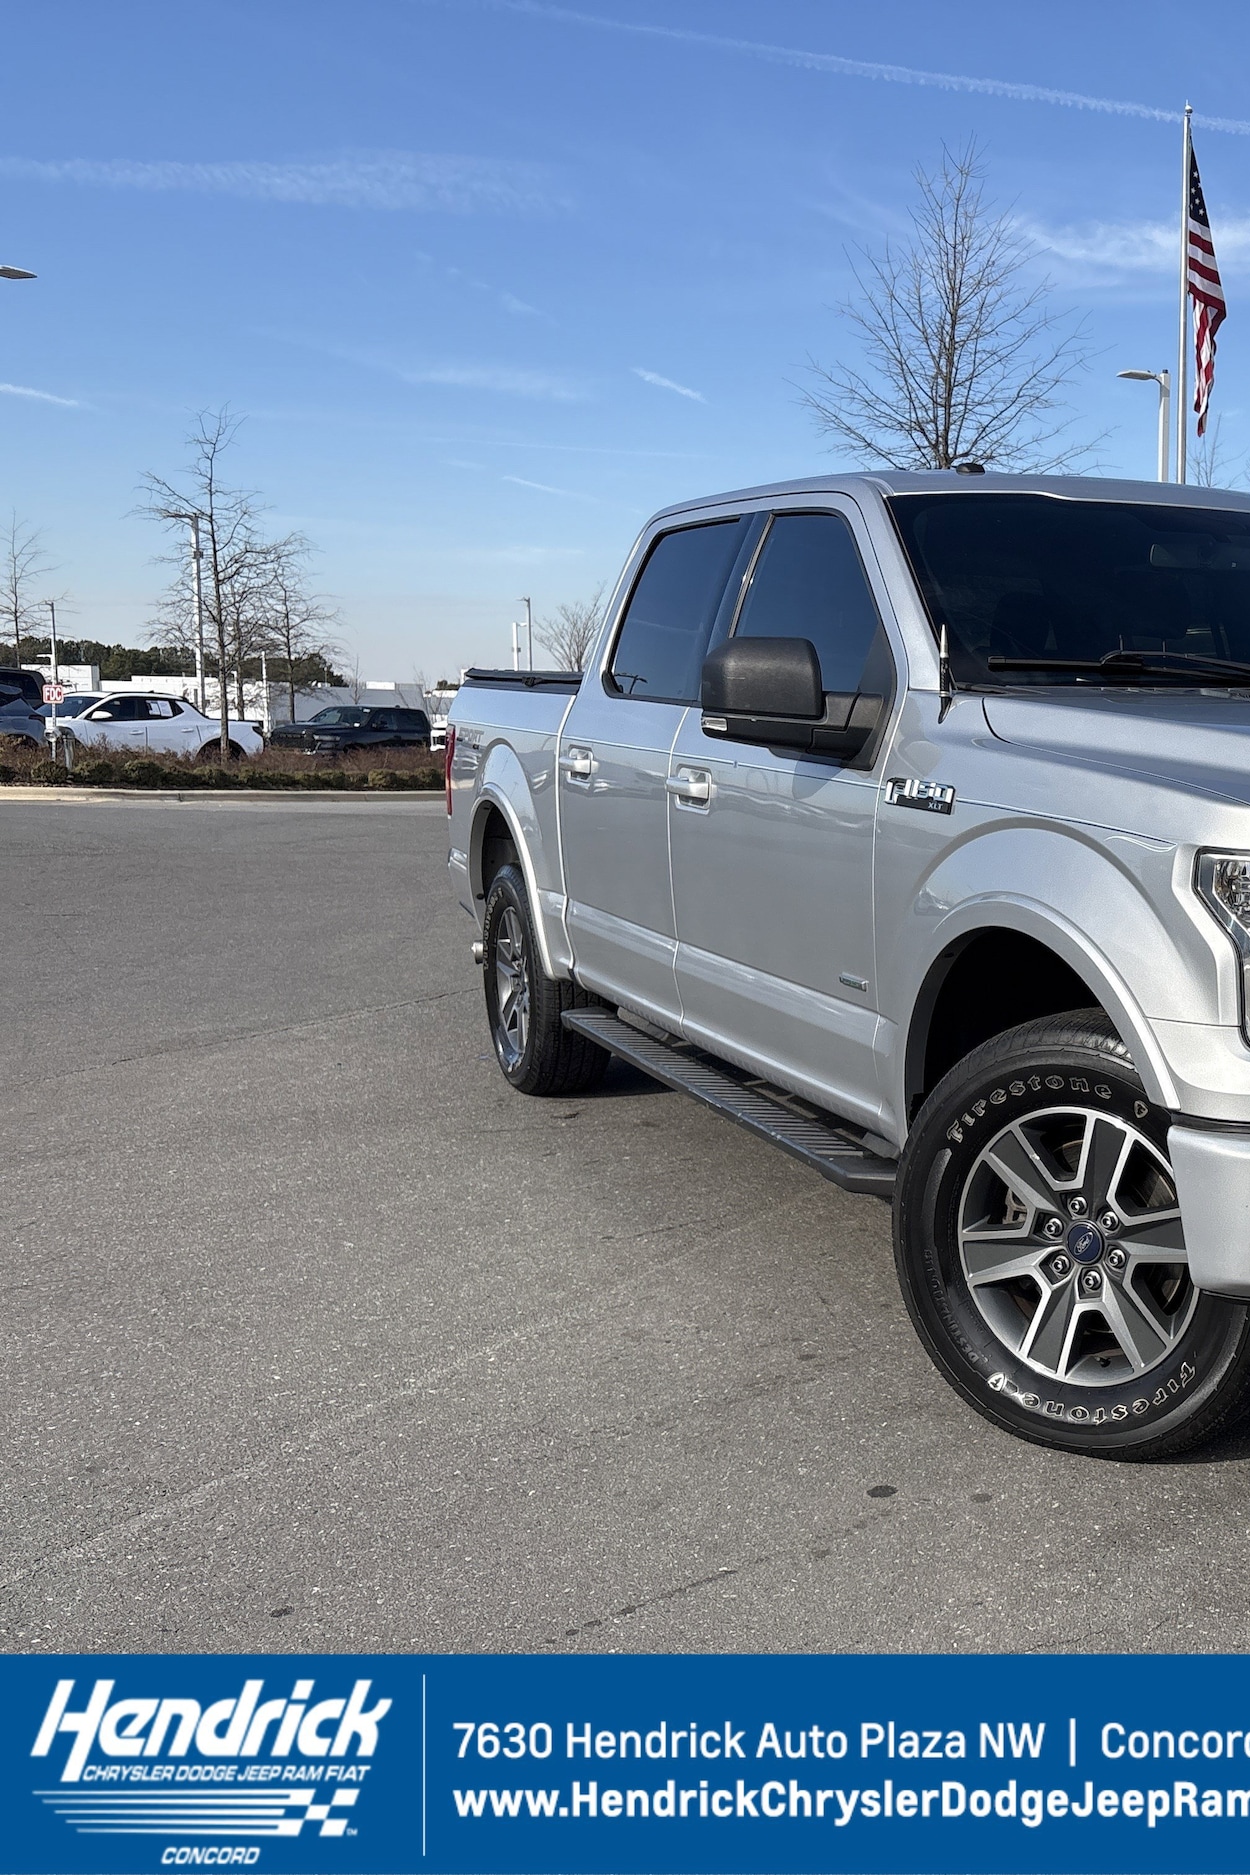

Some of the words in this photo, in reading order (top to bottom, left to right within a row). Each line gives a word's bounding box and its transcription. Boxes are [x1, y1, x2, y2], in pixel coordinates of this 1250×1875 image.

[45, 687, 62, 701] FDC
[928, 802, 943, 810] XLT
[947, 1075, 1112, 1143] Firestone
[1022, 1362, 1196, 1425] Firestone
